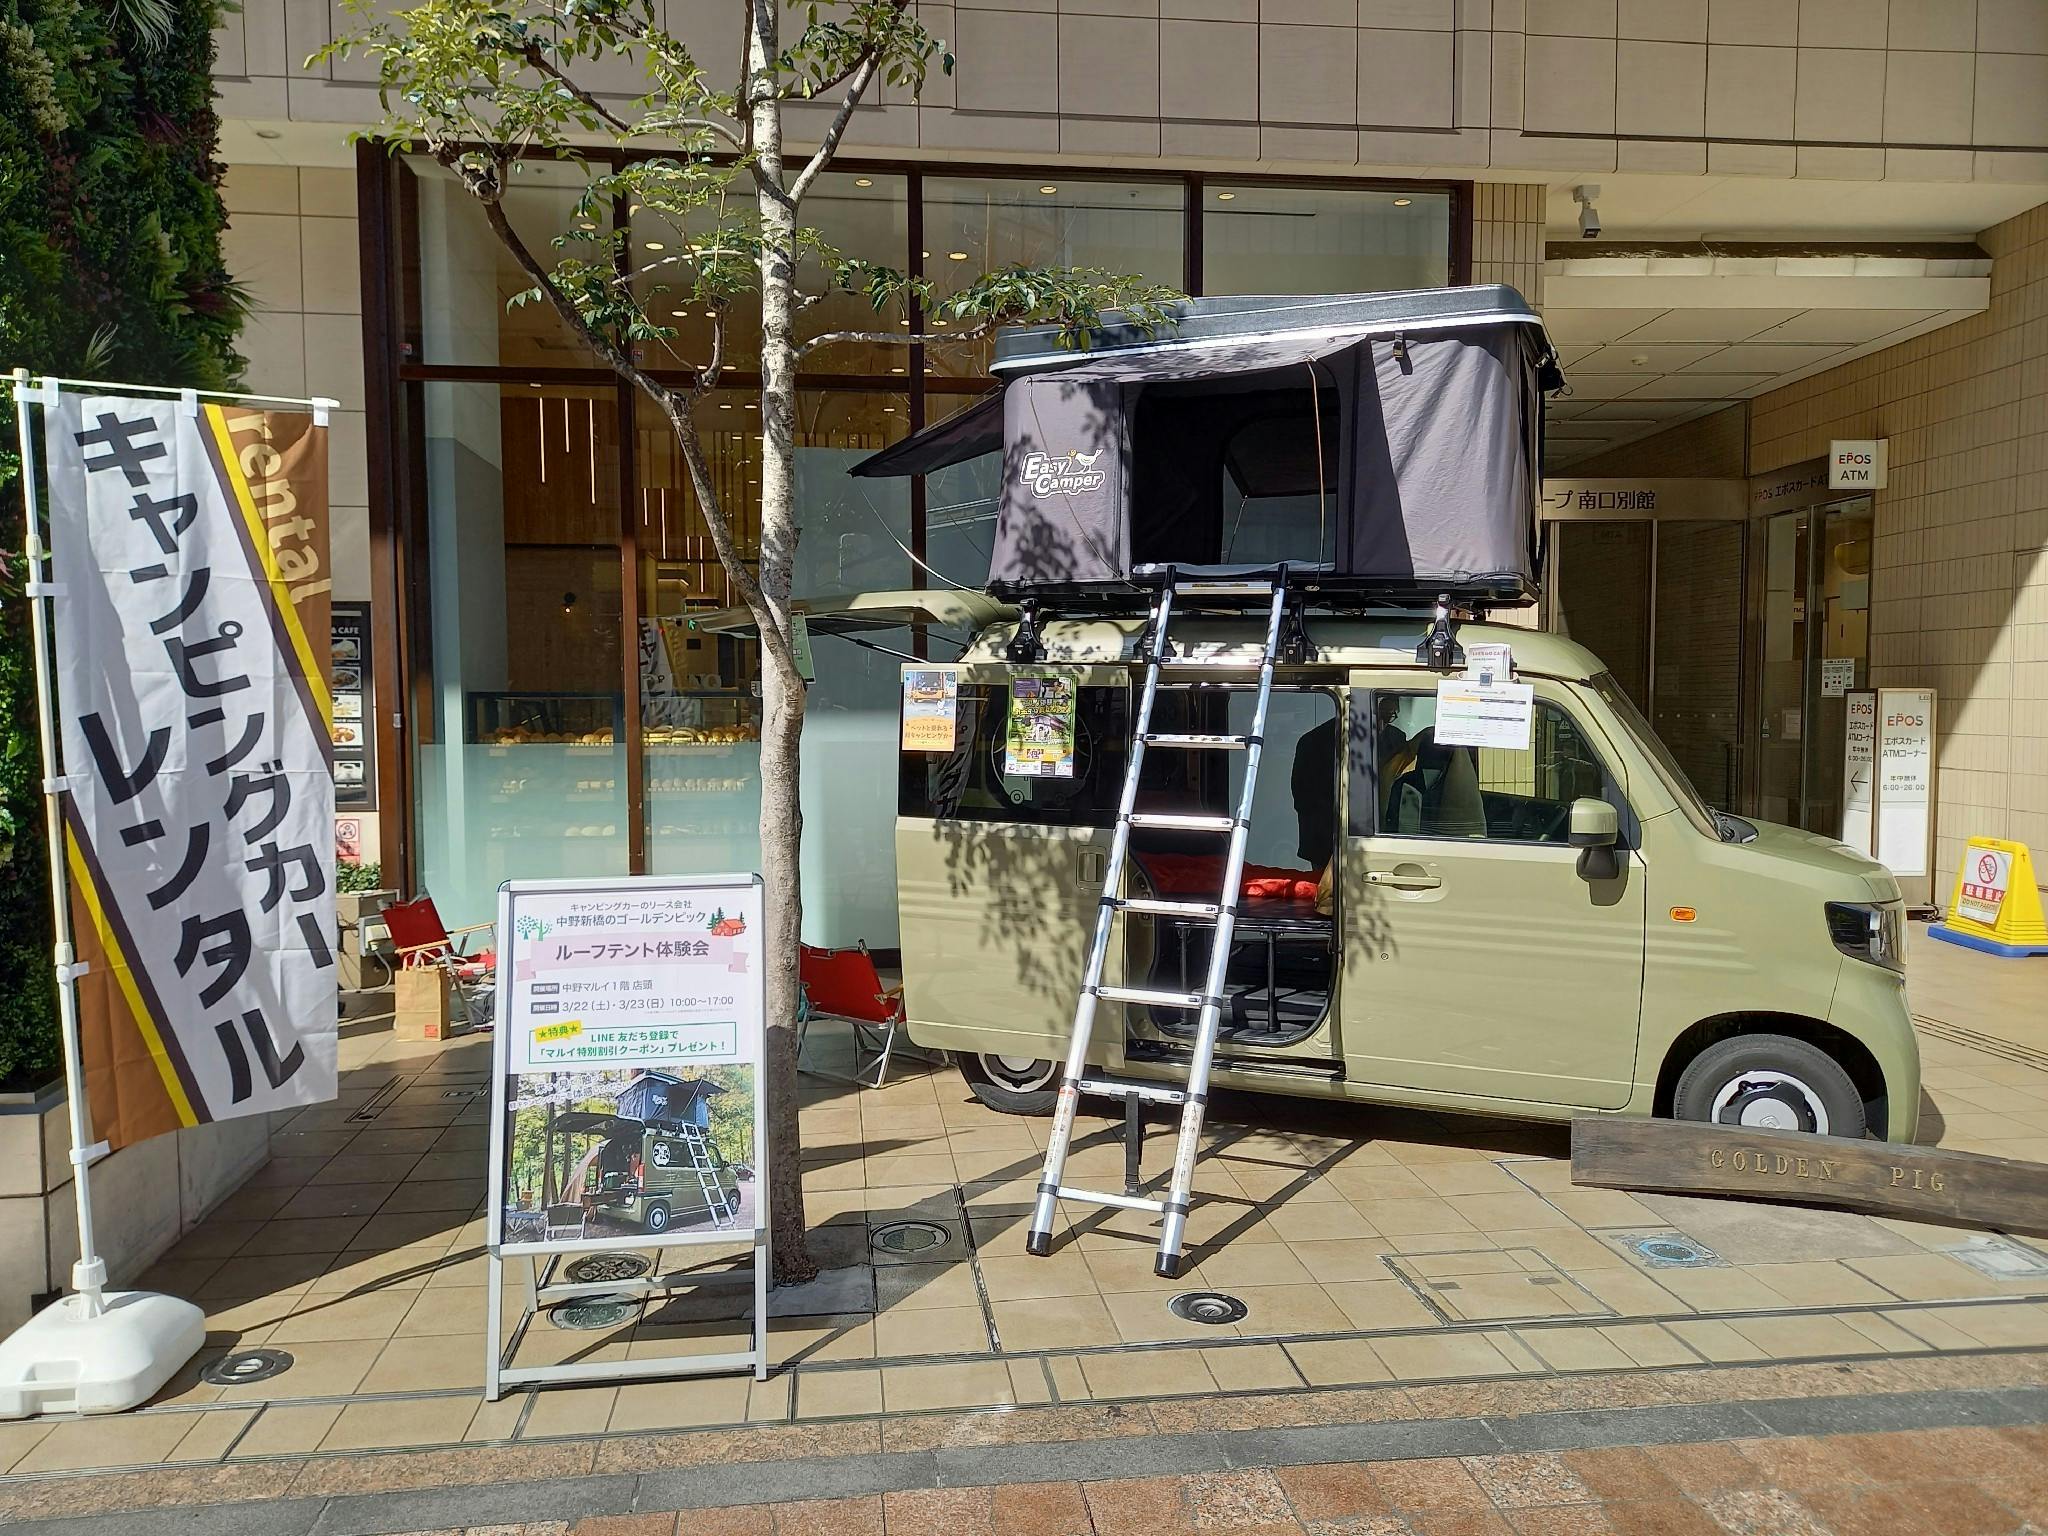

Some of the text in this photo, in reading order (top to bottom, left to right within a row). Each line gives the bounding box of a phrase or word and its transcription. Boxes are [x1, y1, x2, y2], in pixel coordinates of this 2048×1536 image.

[1838, 452, 1871, 464] EPOS
[1025, 456, 1069, 479] Easy
[1840, 470, 1869, 480] ATM
[1035, 474, 1101, 494] Camper
[1578, 489, 1656, 510] 南口別館
[226, 412, 331, 605] rental
[338, 626, 359, 634] CAFE
[74, 412, 333, 968] キャンピングカー
[1851, 701, 1872, 714] EPOS
[1887, 713, 1923, 726] EPOS
[1848, 733, 1874, 742] ATMコーナー
[1884, 736, 1926, 745] エポスカード
[1882, 749, 1927, 758] ATMコーナー
[79, 711, 304, 1104] レンタル
[570, 900, 692, 912] キャンピングカーのリース会社
[556, 940, 709, 960] ルーフテント体験会
[591, 1030, 679, 1042] LINE 友だち登録で
[1711, 1149, 1944, 1193] GOLDEN PIG
